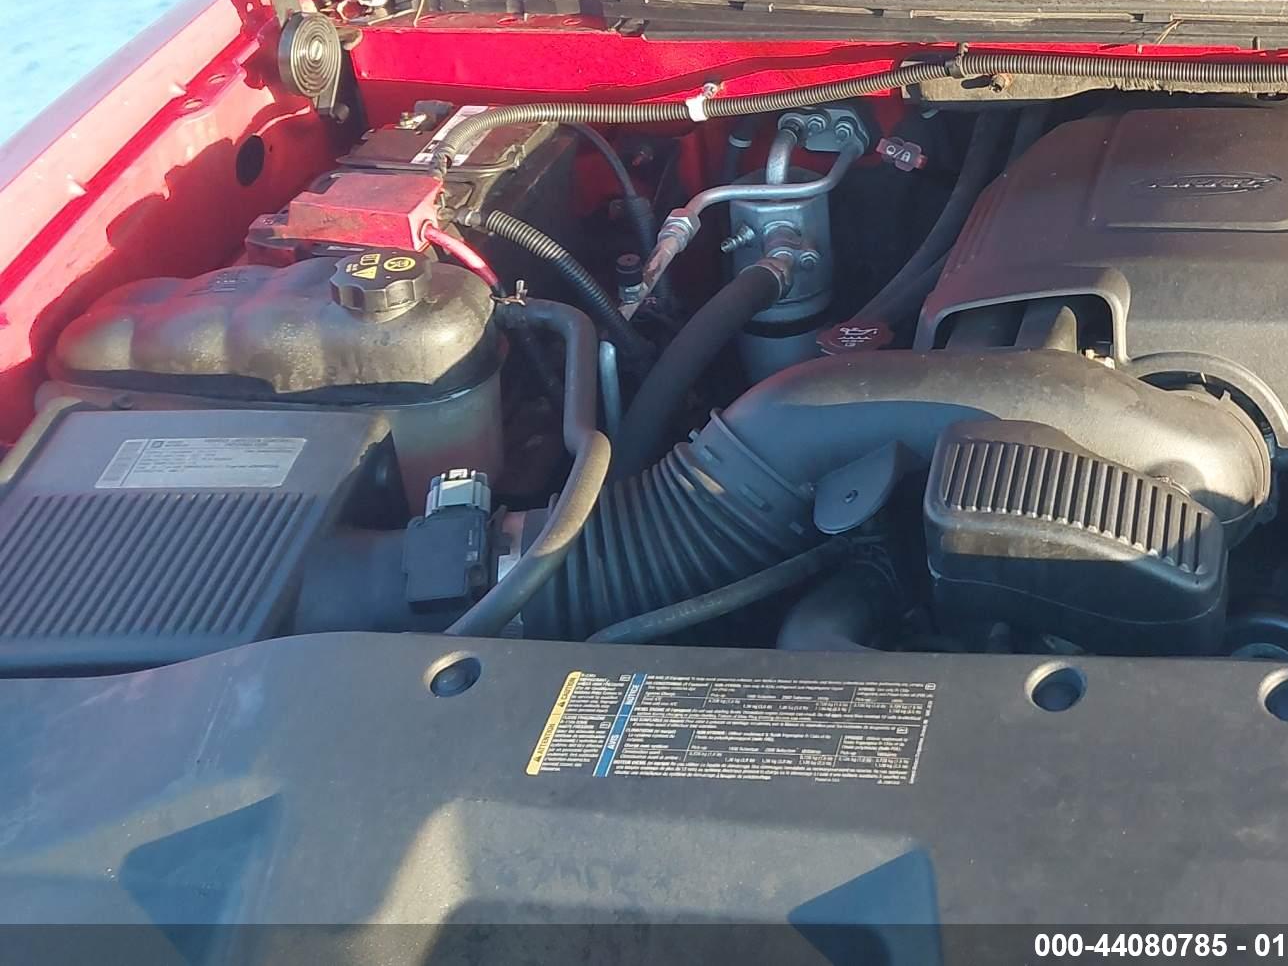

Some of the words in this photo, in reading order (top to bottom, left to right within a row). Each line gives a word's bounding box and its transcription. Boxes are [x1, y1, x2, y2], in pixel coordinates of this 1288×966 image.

[561, 677, 576, 702] CAUTION
[625, 685, 639, 705] NOTICE
[539, 723, 556, 755] ATTENTION
[607, 734, 619, 750] AVIS
